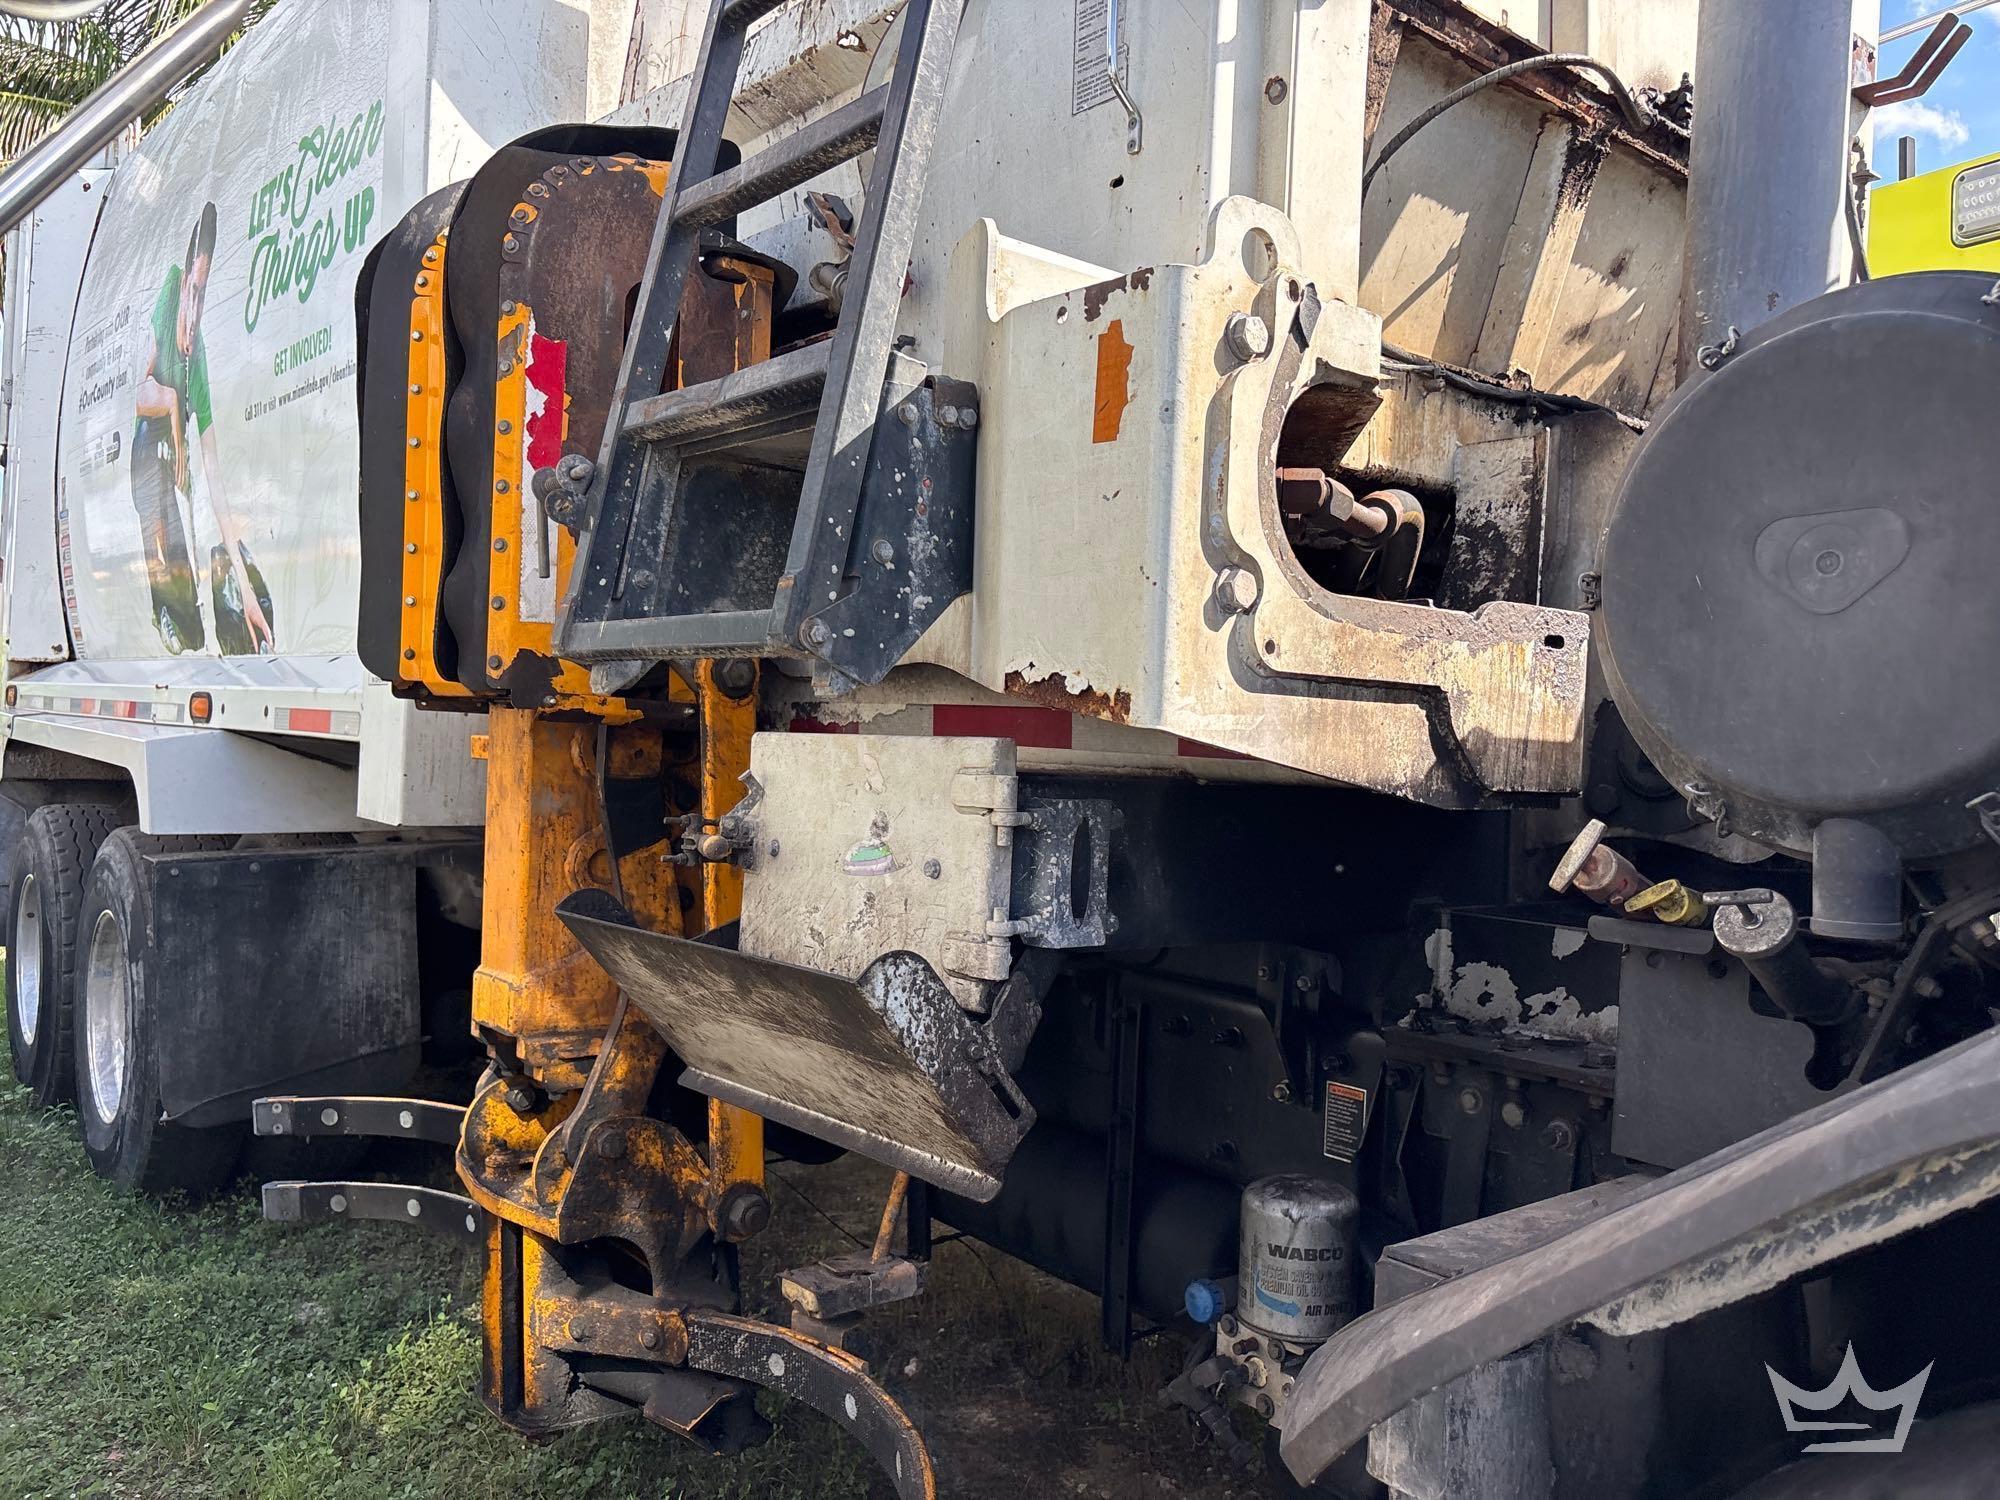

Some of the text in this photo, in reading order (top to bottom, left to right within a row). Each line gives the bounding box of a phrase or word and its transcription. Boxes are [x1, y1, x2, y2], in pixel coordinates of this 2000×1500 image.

[248, 98, 386, 240] LET'S Clean
[244, 185, 375, 334] Things UP
[273, 325, 332, 377] GET INVOLVED!
[1267, 1242, 1344, 1261] WABCO
[1305, 1304, 1322, 1317] AIR
